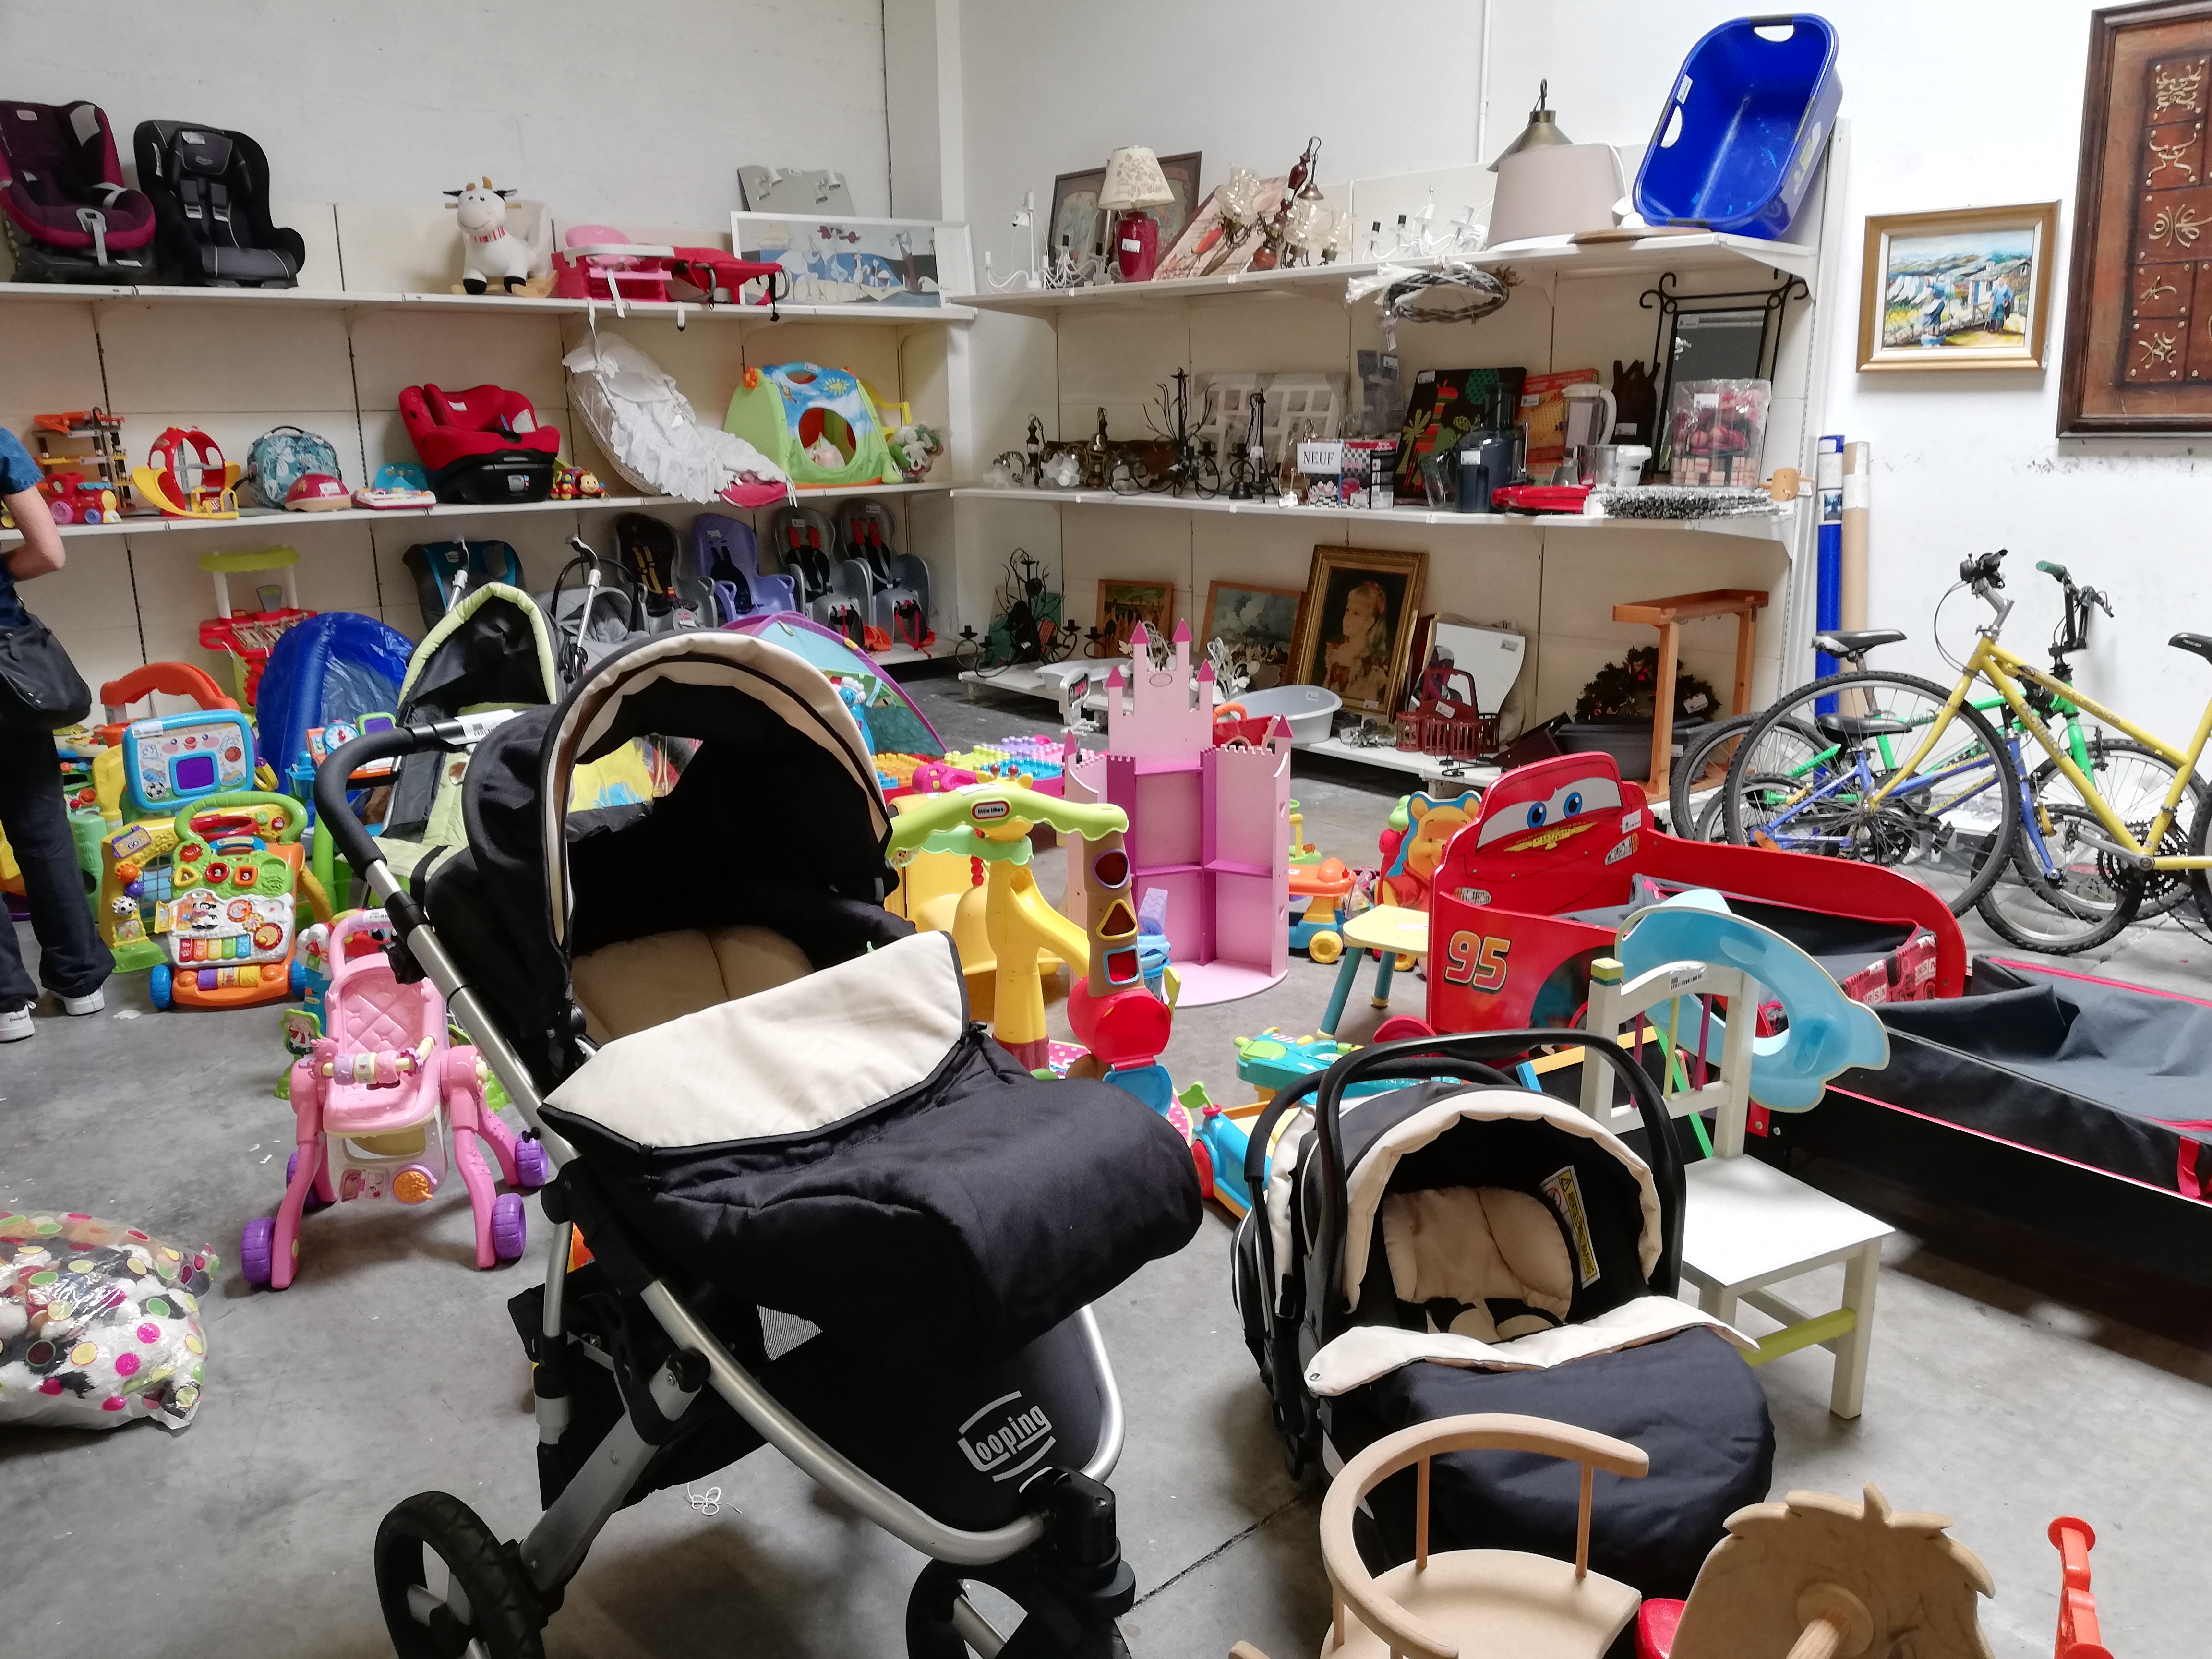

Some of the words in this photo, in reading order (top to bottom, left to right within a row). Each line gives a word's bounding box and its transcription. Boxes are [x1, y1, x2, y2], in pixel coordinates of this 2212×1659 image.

[1303, 451, 1334, 466] NEUF
[215, 868, 222, 877] 2
[242, 872, 250, 880] 3
[1444, 930, 1512, 994] 95
[957, 1405, 1052, 1472] Looping
